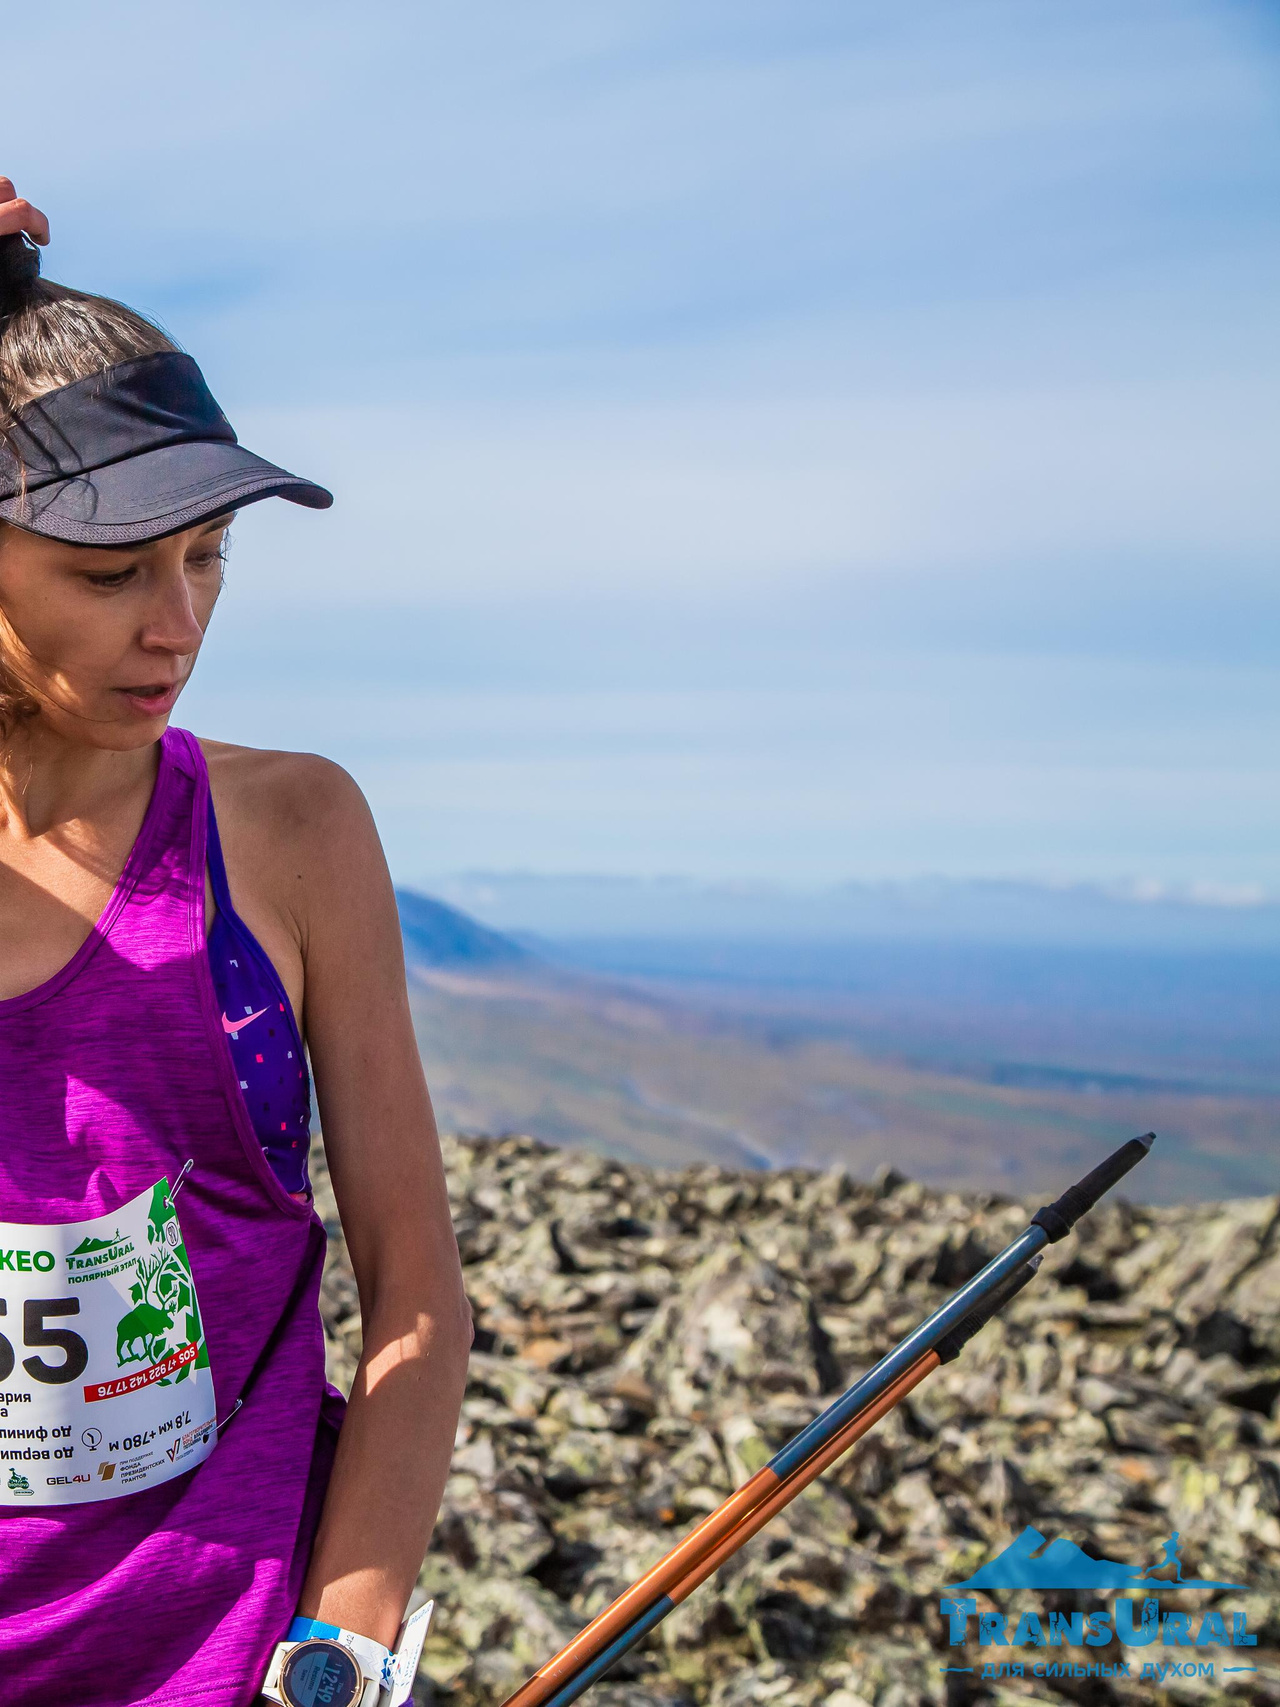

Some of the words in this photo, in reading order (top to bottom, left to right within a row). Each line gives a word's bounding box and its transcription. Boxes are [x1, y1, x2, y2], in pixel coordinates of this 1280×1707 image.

[68, 1265, 121, 1285] ПОЛЯРНЫЙ
[120, 1257, 138, 1272] ЭТАП
[179, 1346, 196, 1364] SOS
[149, 1365, 167, 1379] 922
[168, 1359, 177, 1371] +7
[116, 1381, 129, 1394] 17
[129, 1373, 148, 1389] 142
[97, 1386, 114, 1398] 76
[175, 1410, 192, 1428] 7,8
[52, 1425, 72, 1438] до
[123, 1430, 157, 1451] +780
[53, 1446, 74, 1459] до
[120, 1462, 141, 1472] ФОНДА
[121, 1459, 165, 1478] ПРЕЗИДЕНТСКИХ
[46, 1474, 91, 1486] GEL4U
[122, 1472, 147, 1484] ГРАНТОВ
[308, 1666, 321, 1691] Resume
[317, 1666, 341, 1703] 12:49
